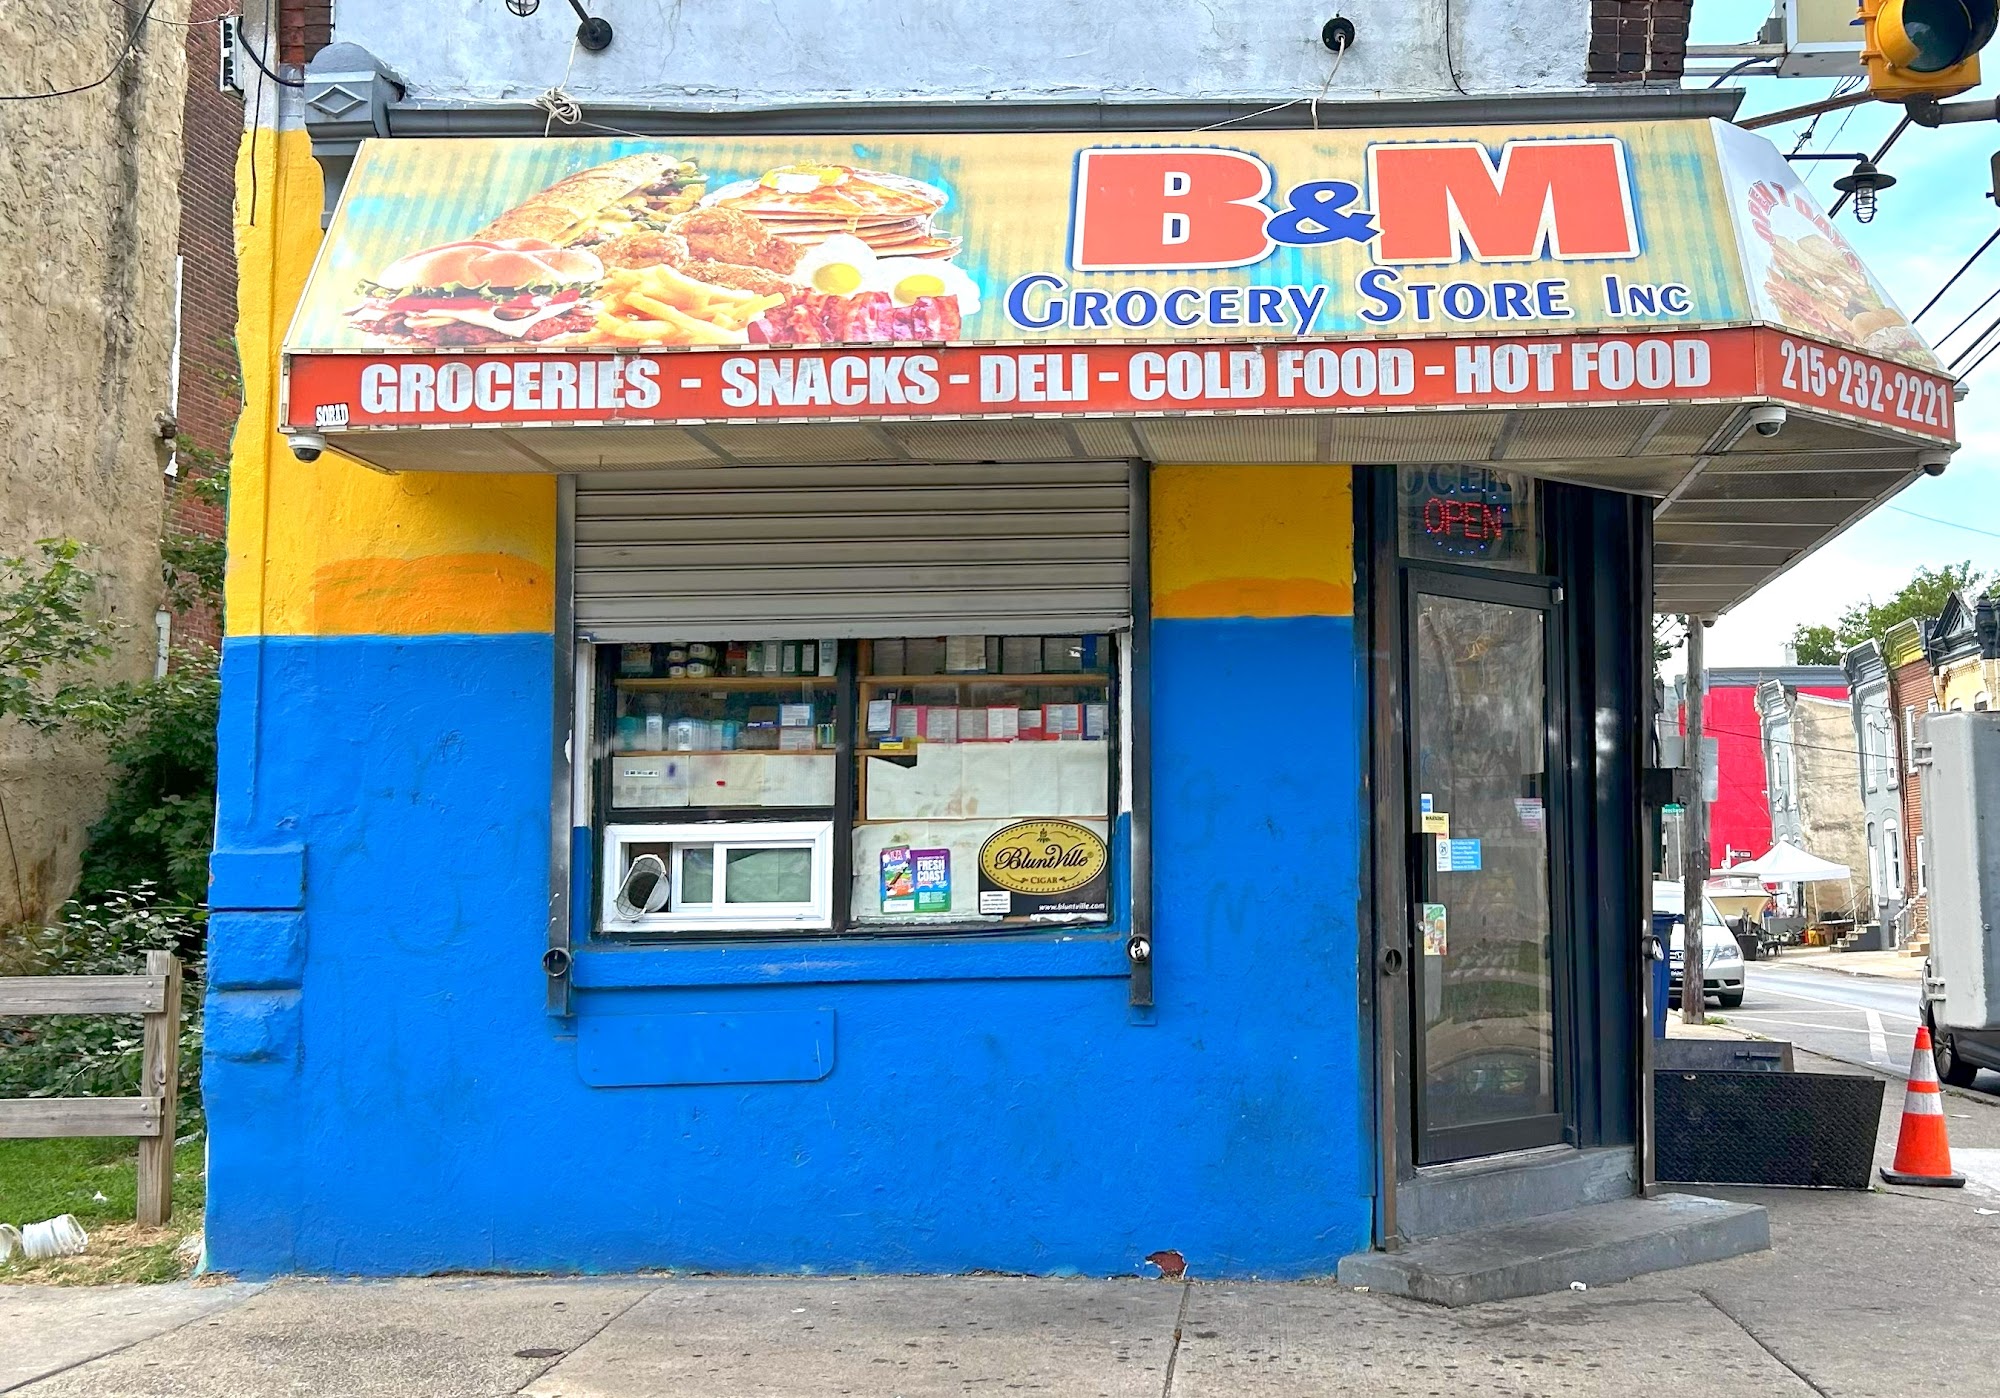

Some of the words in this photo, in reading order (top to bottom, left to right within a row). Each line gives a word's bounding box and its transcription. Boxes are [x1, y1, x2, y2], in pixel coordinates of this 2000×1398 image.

[1072, 137, 1642, 273] B&M
[359, 356, 662, 415] GROCERIES
[721, 353, 941, 407] SNACKS
[979, 352, 1090, 403] DELI
[1128, 350, 1267, 401] COLD
[1276, 347, 1415, 398] FOOD
[1454, 342, 1562, 394] HOT
[1572, 338, 1712, 392] FOOD
[1423, 496, 1503, 541] OPEN
[916, 859, 945, 871] FRESH
[993, 842, 1088, 870] BluntVille
[916, 870, 945, 882] COAST
[1030, 876, 1058, 885] CIGAR
[1038, 902, 1106, 911] www.bluntville.com
